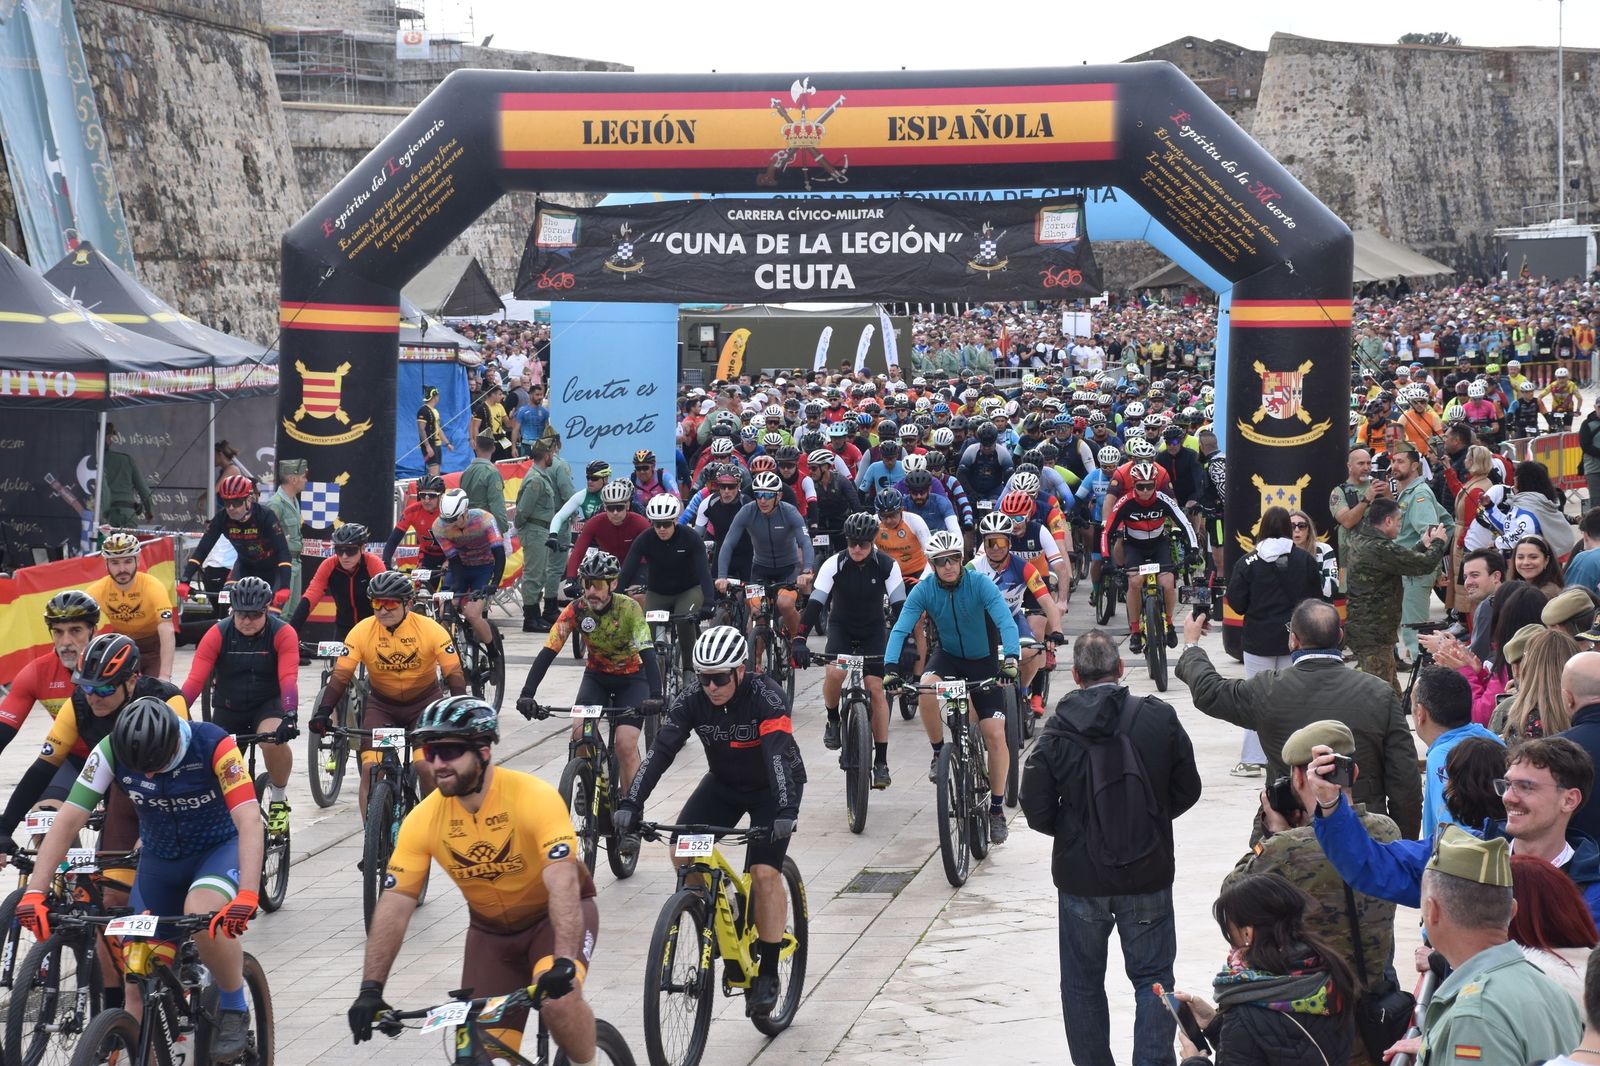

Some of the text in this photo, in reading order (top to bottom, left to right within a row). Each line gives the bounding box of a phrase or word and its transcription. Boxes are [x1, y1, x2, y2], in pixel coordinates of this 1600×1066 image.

[582, 109, 1054, 145] LEGIÓN ESPAÑOLA
[1169, 109, 1295, 229] Espíritu de la Muerte
[321, 120, 444, 238] Espíritu del Legionario
[728, 207, 884, 220] CARRERA CÍVICO-MILITAR
[543, 217, 559, 226] The
[1044, 222, 1076, 230] Corner
[542, 226, 573, 234] Corner
[1044, 230, 1068, 238] Shop
[542, 234, 563, 242] Shop
[756, 233, 789, 254] DE
[799, 233, 832, 254] LA
[754, 264, 856, 289] CEUTA
[636, 382, 658, 397] es
[565, 413, 659, 449] Deporte
[948, 686, 964, 695] 416
[773, 754, 788, 808] CARBON
[691, 841, 710, 851] 525
[450, 857, 525, 880] TITANES
[128, 920, 152, 931] 120
